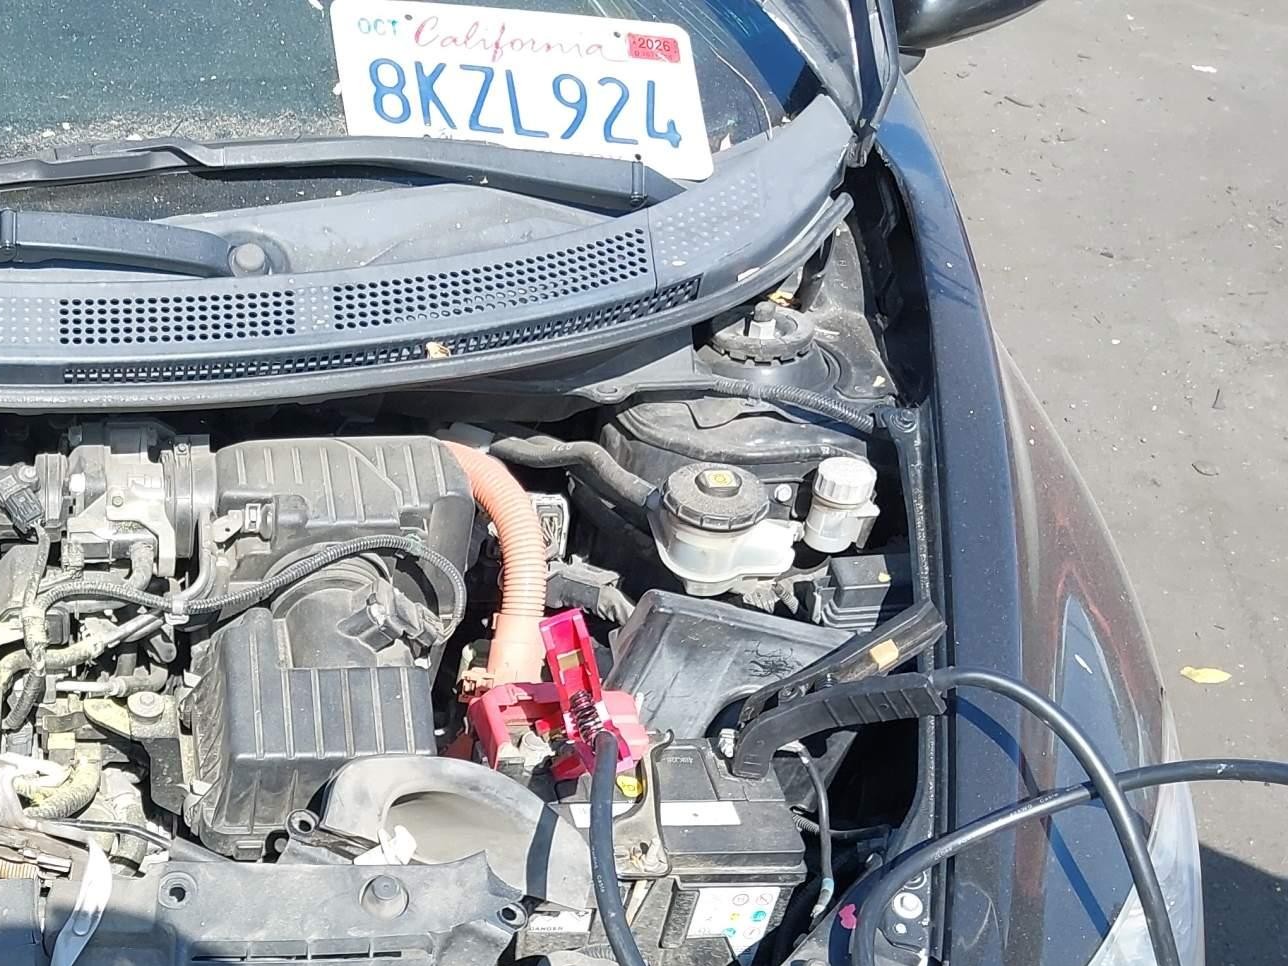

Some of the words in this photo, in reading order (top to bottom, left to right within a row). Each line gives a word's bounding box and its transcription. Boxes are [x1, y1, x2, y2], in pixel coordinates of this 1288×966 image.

[357, 18, 399, 36] OCT
[414, 16, 624, 63] California
[638, 37, 671, 52] 2026
[368, 58, 682, 148] 8KZL924
